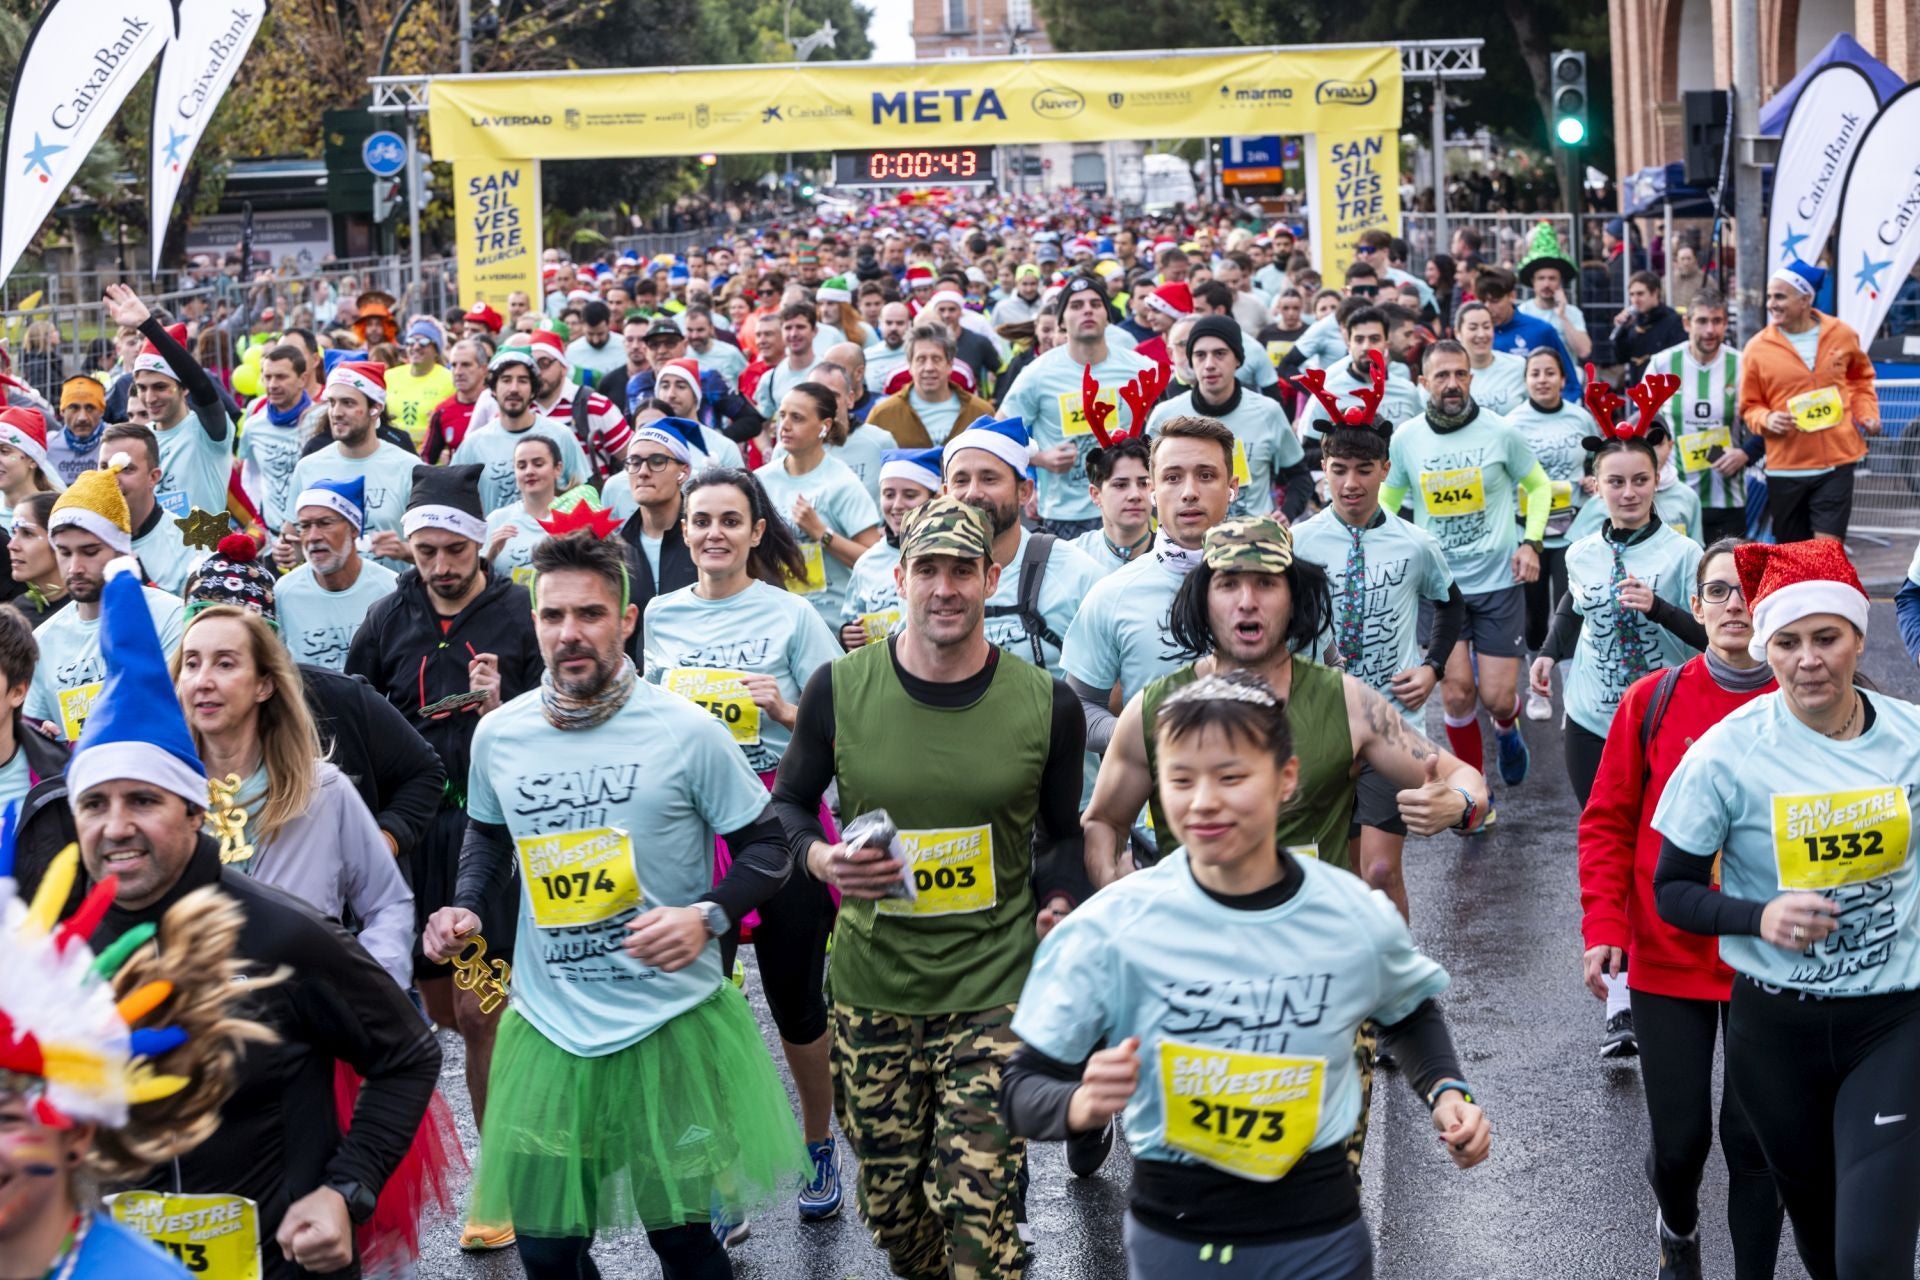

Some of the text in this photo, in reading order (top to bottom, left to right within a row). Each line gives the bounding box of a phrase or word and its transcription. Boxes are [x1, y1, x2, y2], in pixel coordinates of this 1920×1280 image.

[51, 13, 149, 130] CaixaBank
[177, 7, 253, 120] CaixaBank
[1039, 98, 1078, 110] Juver
[1236, 88, 1292, 100] marmo
[1325, 87, 1368, 98] VIDAL
[788, 105, 854, 118] CaixaBank
[871, 88, 1007, 125] META
[471, 115, 553, 127] LA VERDAD
[1331, 136, 1382, 163] SAN
[870, 151, 976, 178] 0:00:43
[1340, 159, 1375, 182] SIL
[1797, 111, 1860, 220] CaixaBank
[469, 169, 520, 196] SAN
[1336, 175, 1381, 201] VES
[478, 192, 512, 215] SIL
[1337, 196, 1383, 221] TRE
[474, 208, 519, 233] VES
[1336, 214, 1388, 235] MURCIA
[475, 228, 522, 253] TRE
[475, 246, 526, 266] MURCIA
[1806, 404, 1832, 419] 420
[1432, 488, 1474, 504] 2414
[514, 763, 641, 816] SAN
[1787, 798, 1832, 823] SAN
[1787, 791, 1896, 840] SILVESTRE
[1853, 809, 1898, 831] MURCIA
[527, 840, 561, 862] SAN
[529, 830, 623, 879] SILVESTRE
[941, 848, 981, 867] MURCIA
[1804, 830, 1884, 862] 1332
[541, 868, 616, 900] 1074
[1161, 973, 1334, 1036] SAN
[1173, 1055, 1231, 1077] SAN
[1173, 1064, 1315, 1097] SILVESTRE
[1189, 1098, 1286, 1144] 2173
[189, 1219, 243, 1241] MURCIA
